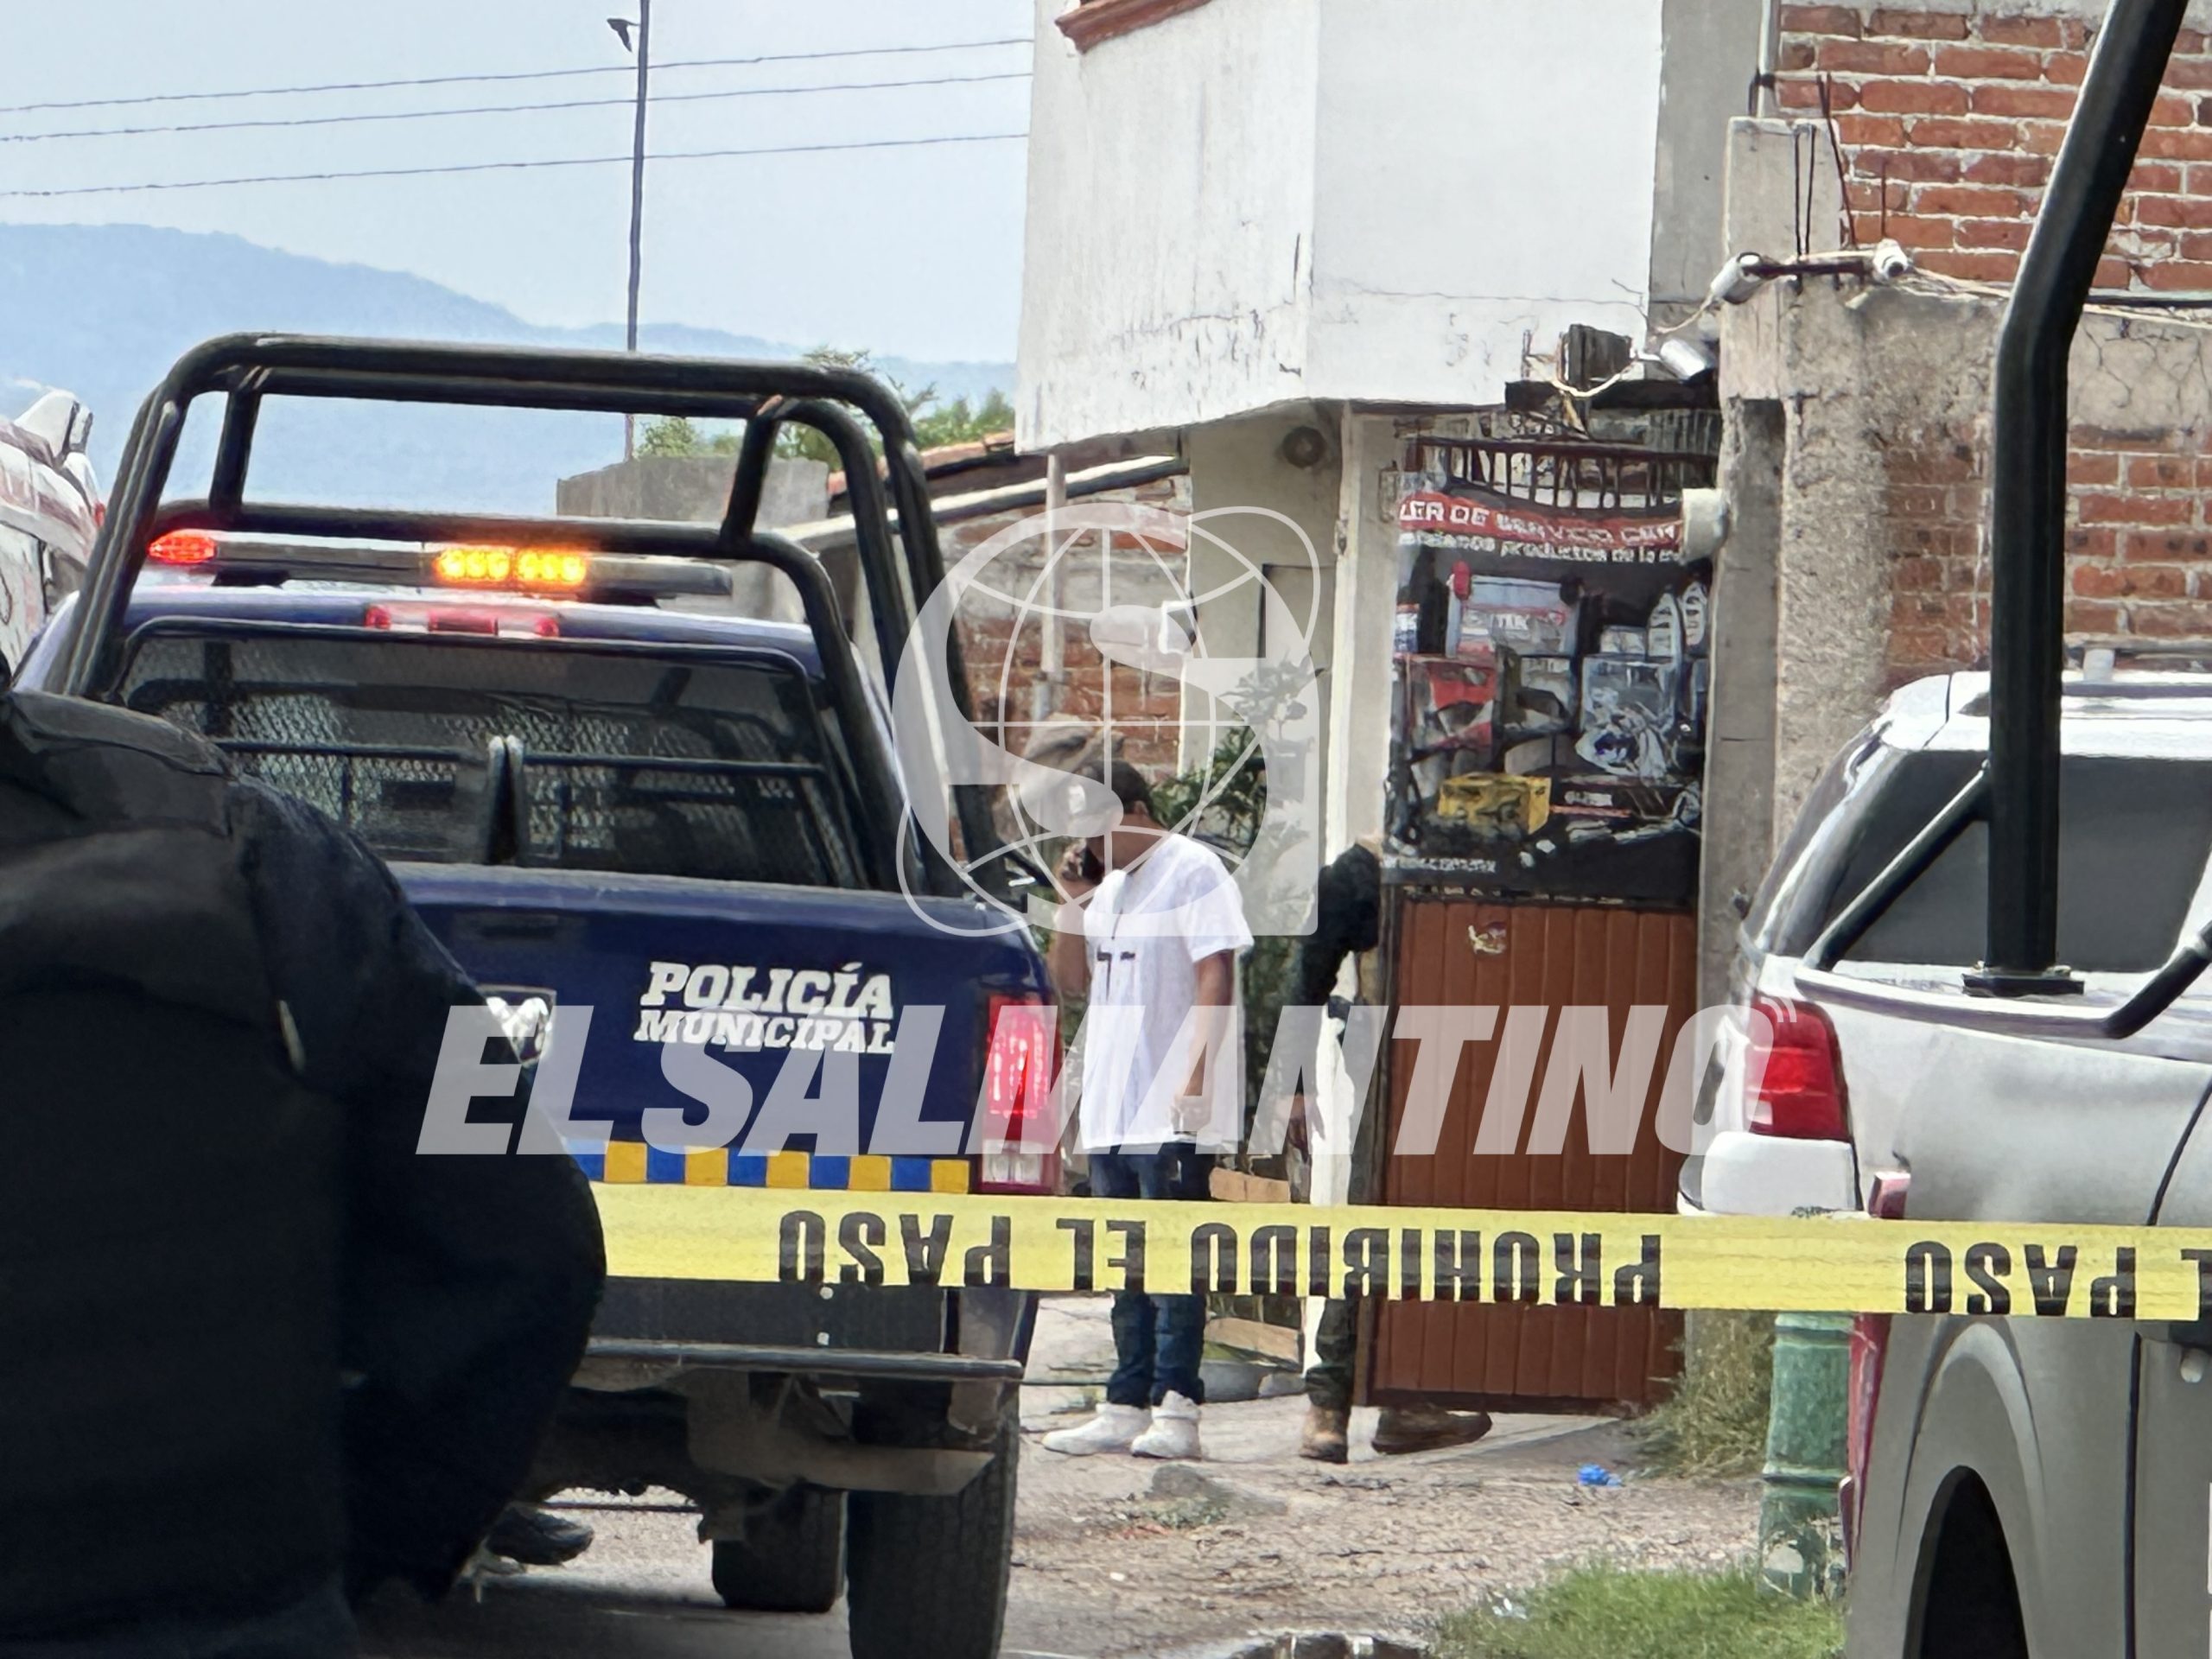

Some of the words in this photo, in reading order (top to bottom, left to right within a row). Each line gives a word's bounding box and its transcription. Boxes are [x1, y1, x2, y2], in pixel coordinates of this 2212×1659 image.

[1399, 500, 1445, 521] LER
[640, 961, 893, 1020] POLICÍA
[633, 1009, 895, 1053] MUNICIPAL
[778, 1210, 1011, 1287] PASO
[1056, 1217, 1147, 1294] EL
[1190, 1221, 1662, 1307] PROHIBIDO
[1904, 1240, 2136, 1319] PASO
